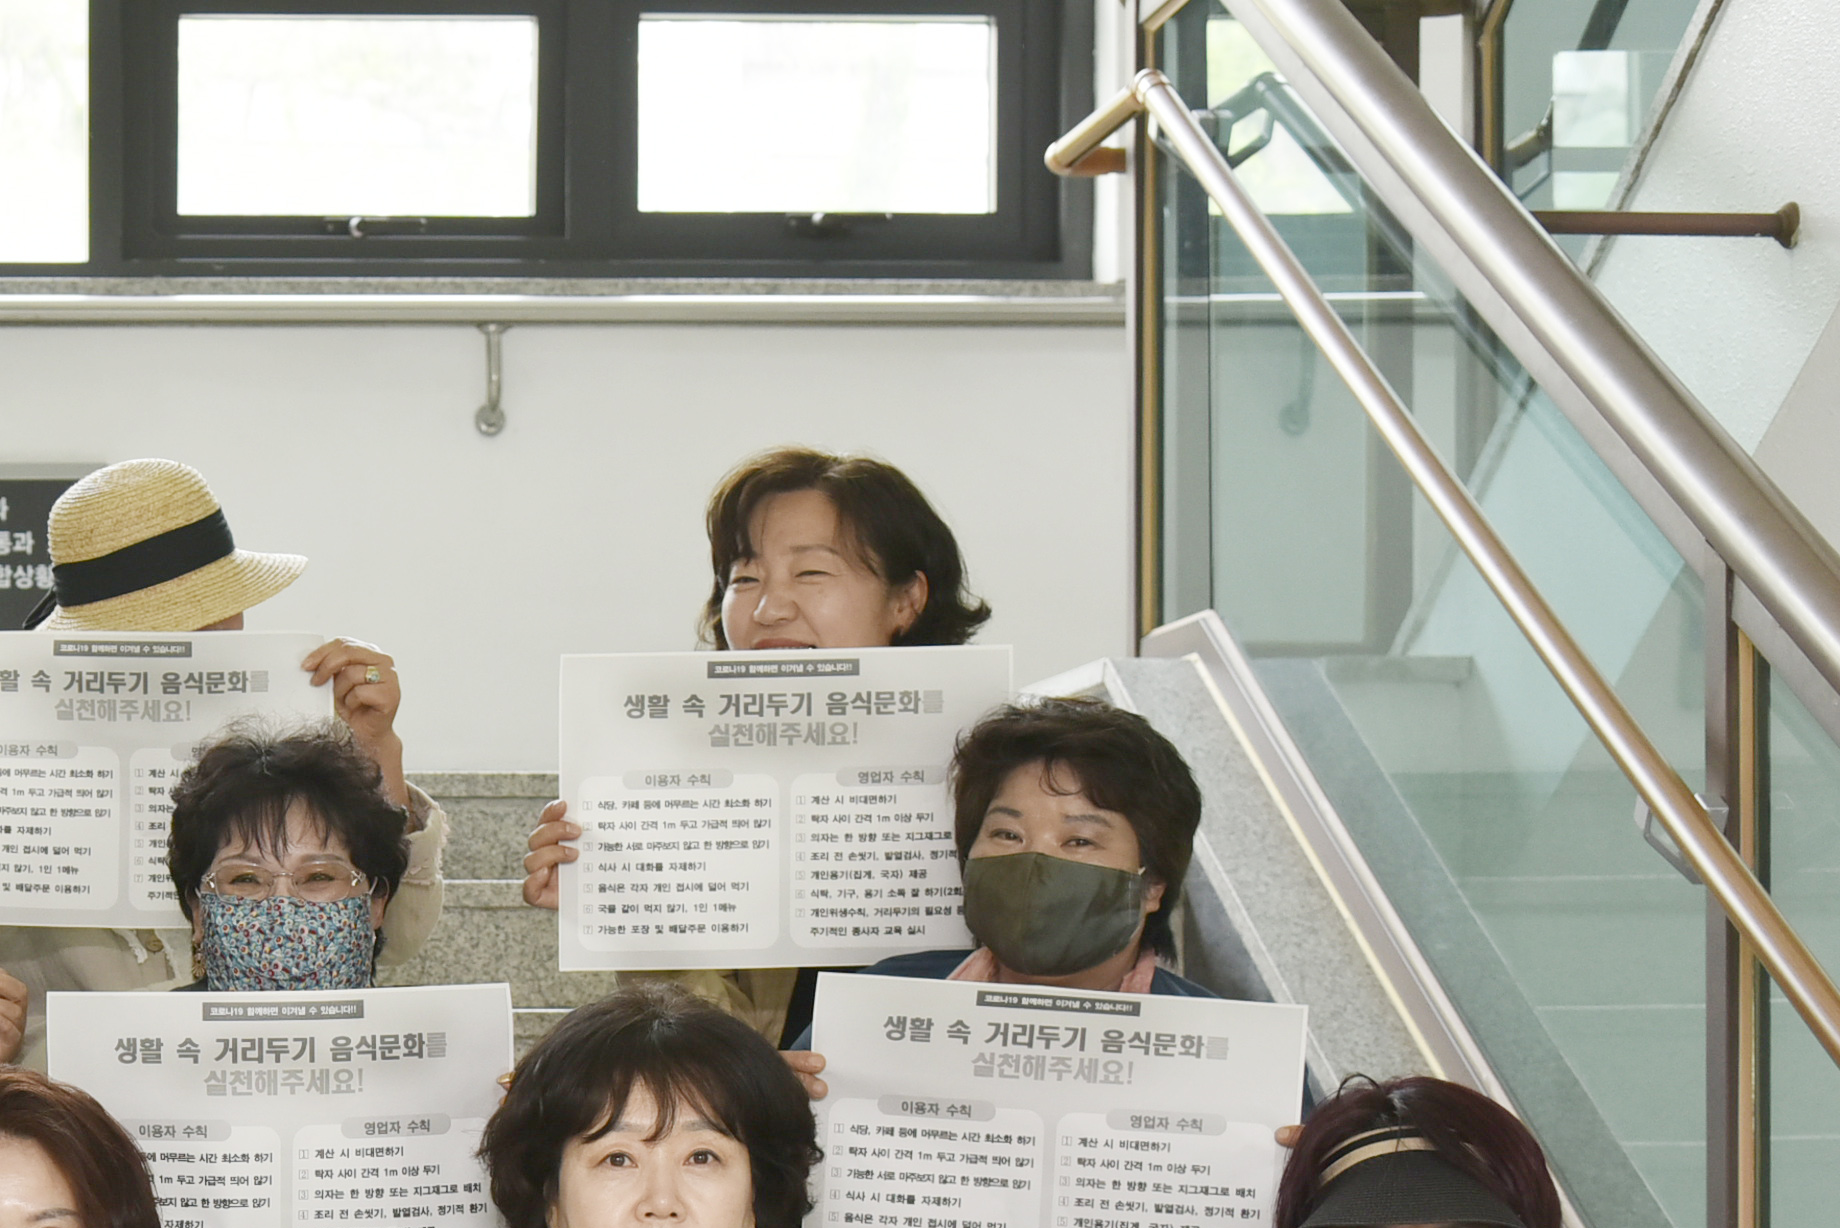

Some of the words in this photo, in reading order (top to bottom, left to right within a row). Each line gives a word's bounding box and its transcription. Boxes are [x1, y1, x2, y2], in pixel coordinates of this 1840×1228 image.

[31, 670, 51, 693] 속
[64, 671, 148, 695] 거리두기
[55, 698, 191, 722] 실천해주세요!
[624, 694, 670, 719] 생활
[682, 694, 705, 718] 속
[718, 692, 812, 717] 거리두기
[708, 722, 858, 747] 실천해주세요!
[36, 745, 58, 756] 수칙
[645, 774, 681, 787] 이용자
[687, 774, 711, 786] 수칙
[858, 770, 894, 784] 영업자
[901, 770, 924, 783] 수칙
[884, 1016, 934, 1042] 생활
[947, 1020, 971, 1045] 속
[985, 1022, 1086, 1052] 거리두기
[115, 1038, 163, 1064] 생활
[177, 1038, 201, 1064] 속
[214, 1037, 315, 1064] 거리두기
[328, 1033, 447, 1062] 음식문화를
[971, 1052, 1133, 1084] 실천해주세요!
[203, 1068, 363, 1096] 실천해주세요!
[902, 1101, 940, 1115] 이용자
[946, 1104, 971, 1118] 수칙
[139, 1125, 176, 1138] 이용자
[182, 1125, 207, 1138] 수칙
[365, 1121, 401, 1135] 영업자
[408, 1119, 430, 1133] 수칙
[1130, 1115, 1169, 1130] 영업자
[1176, 1118, 1203, 1132] 수칙
